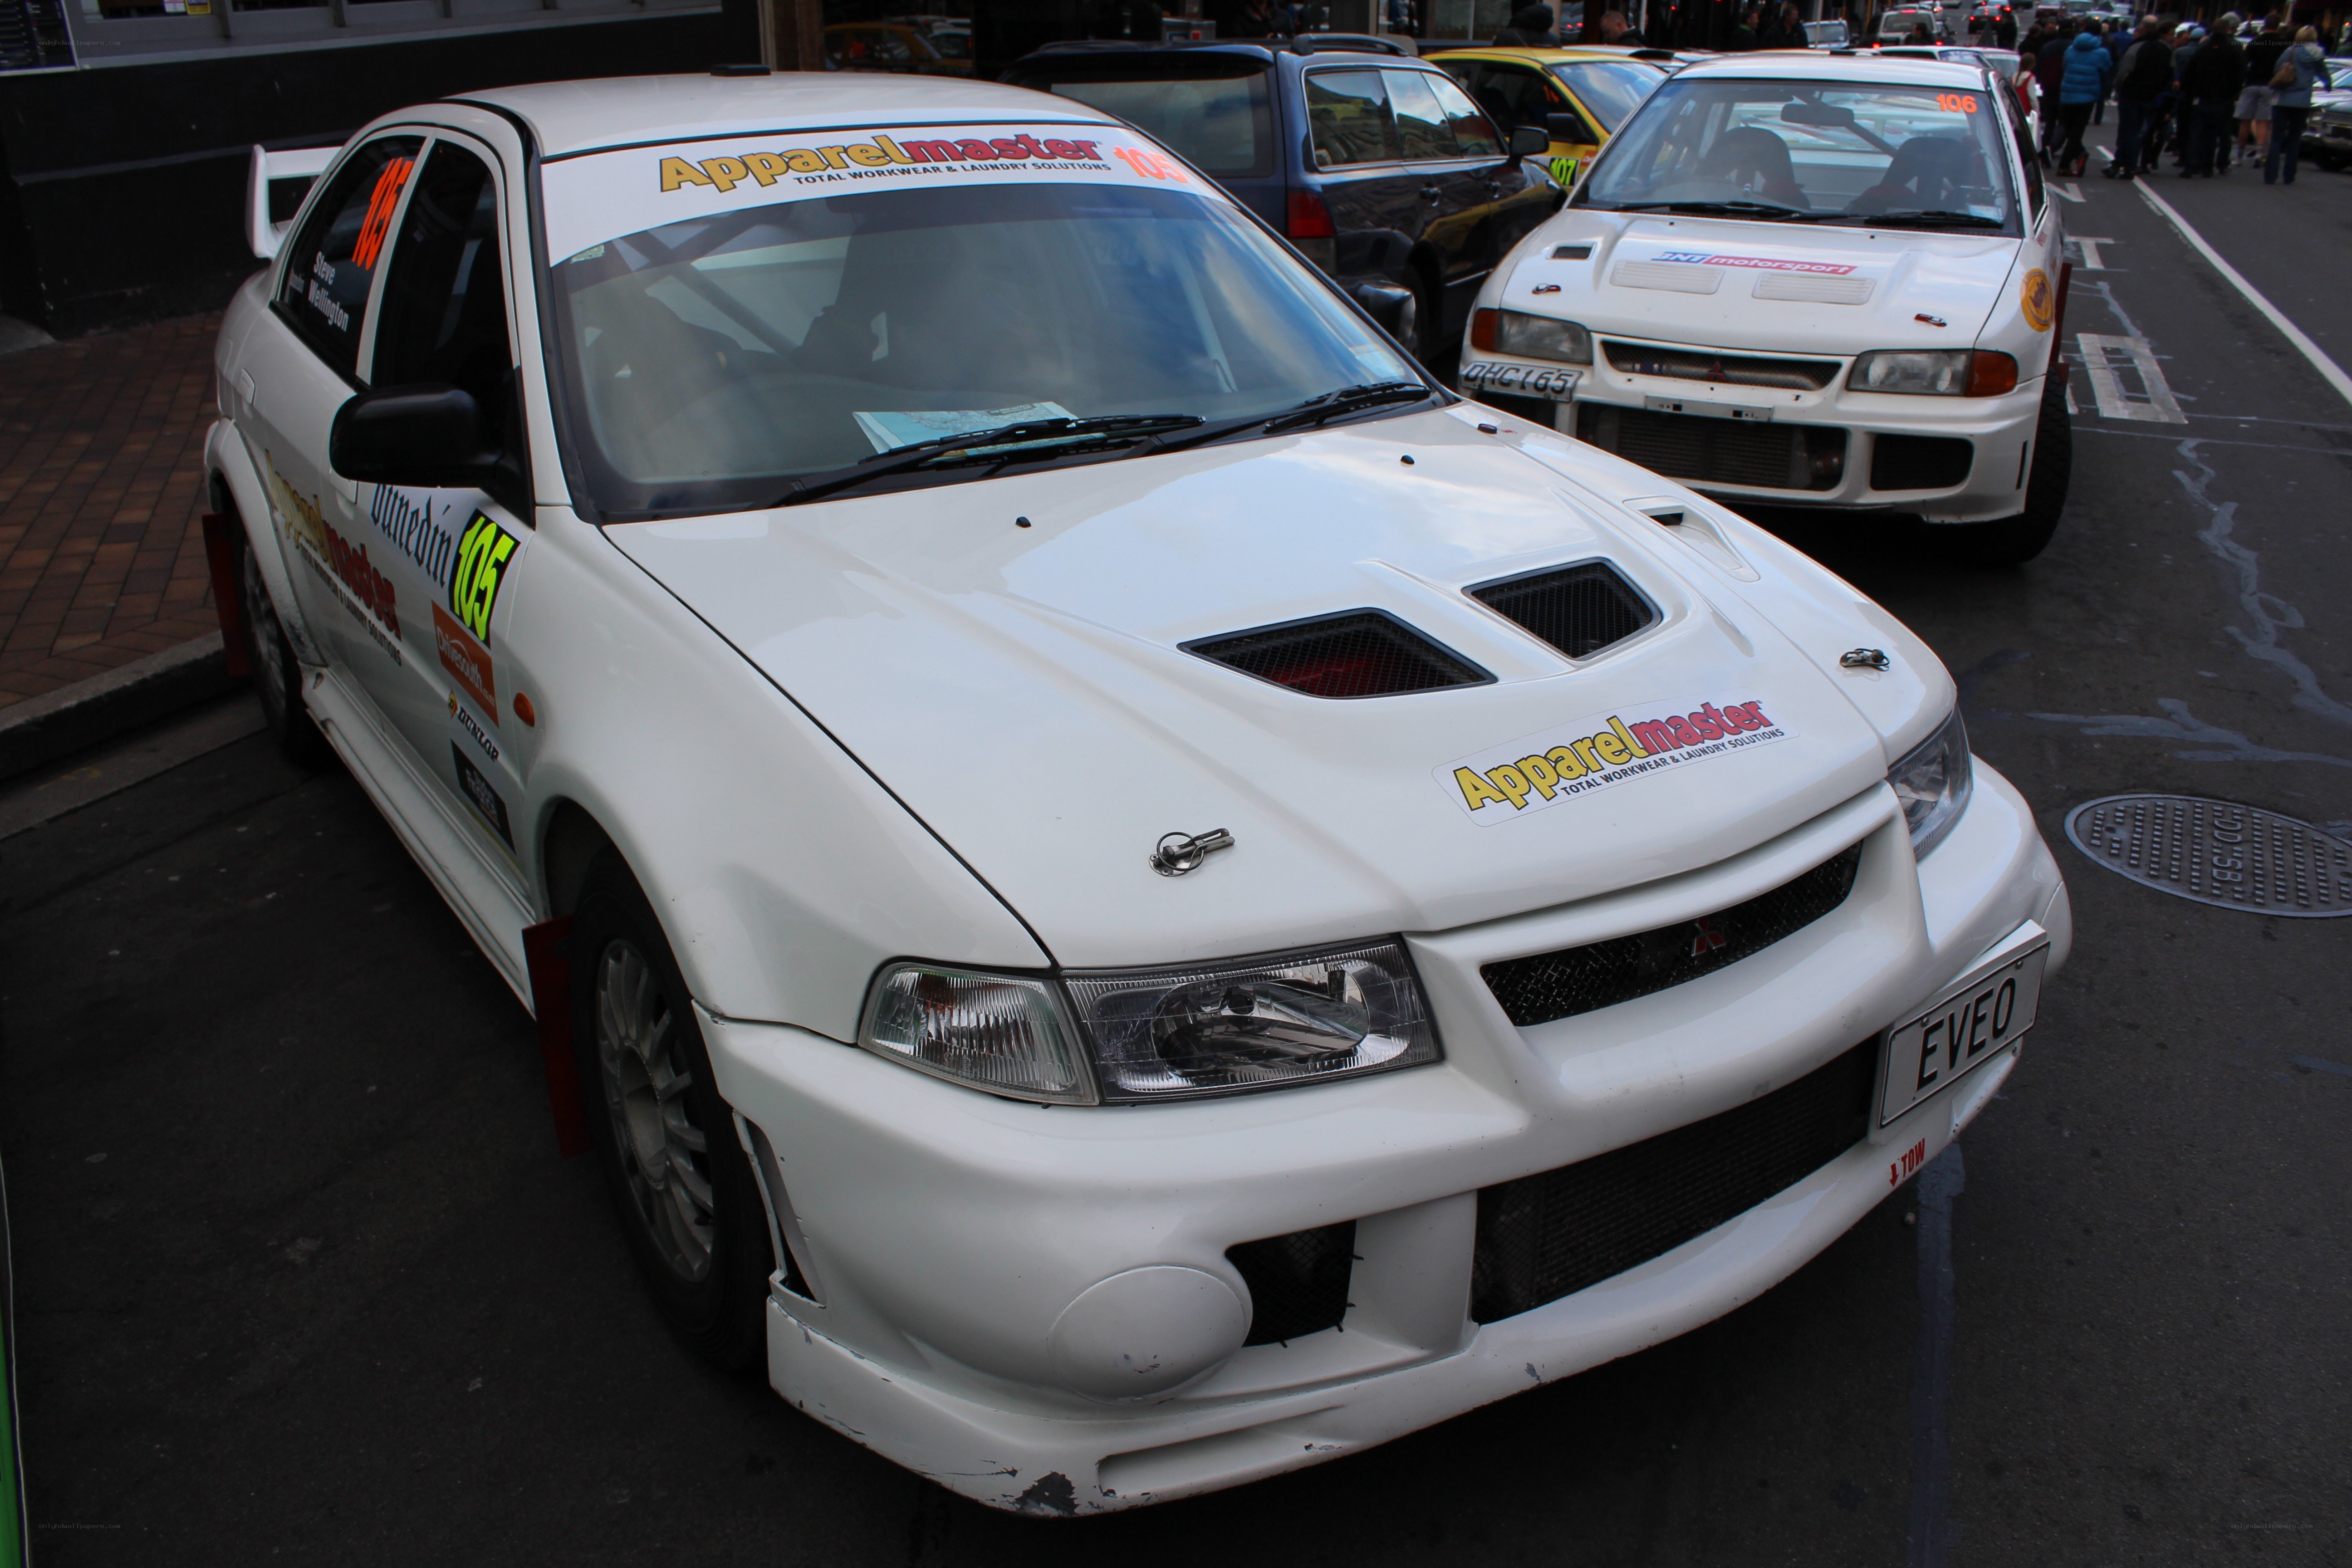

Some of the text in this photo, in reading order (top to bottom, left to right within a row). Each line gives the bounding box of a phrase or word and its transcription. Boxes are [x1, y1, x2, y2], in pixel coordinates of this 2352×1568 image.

[1936, 93, 1978, 113] 106
[659, 133, 1101, 194] Apparelmaster
[793, 172, 846, 185] TOTAL
[848, 166, 942, 180] WORKWEAR
[962, 163, 1029, 172] LAUNDRY
[1033, 162, 1112, 171] SOLUTIONS
[1113, 146, 1188, 183] 105
[1551, 158, 1577, 186] 107
[352, 157, 414, 270] 105
[313, 251, 336, 285] Steve
[1711, 258, 1850, 273] motorsport
[308, 279, 349, 333] Wellington
[454, 516, 515, 642] 105
[368, 619, 402, 666] SOLUTIONS
[458, 706, 499, 762] DUNLOP
[1453, 702, 1774, 811] Apparelmaster
[1561, 728, 1785, 796] TOTAL WORKWEAR & LAUNDRY SOLUTIONS
[1901, 1137, 1926, 1179] TOW
